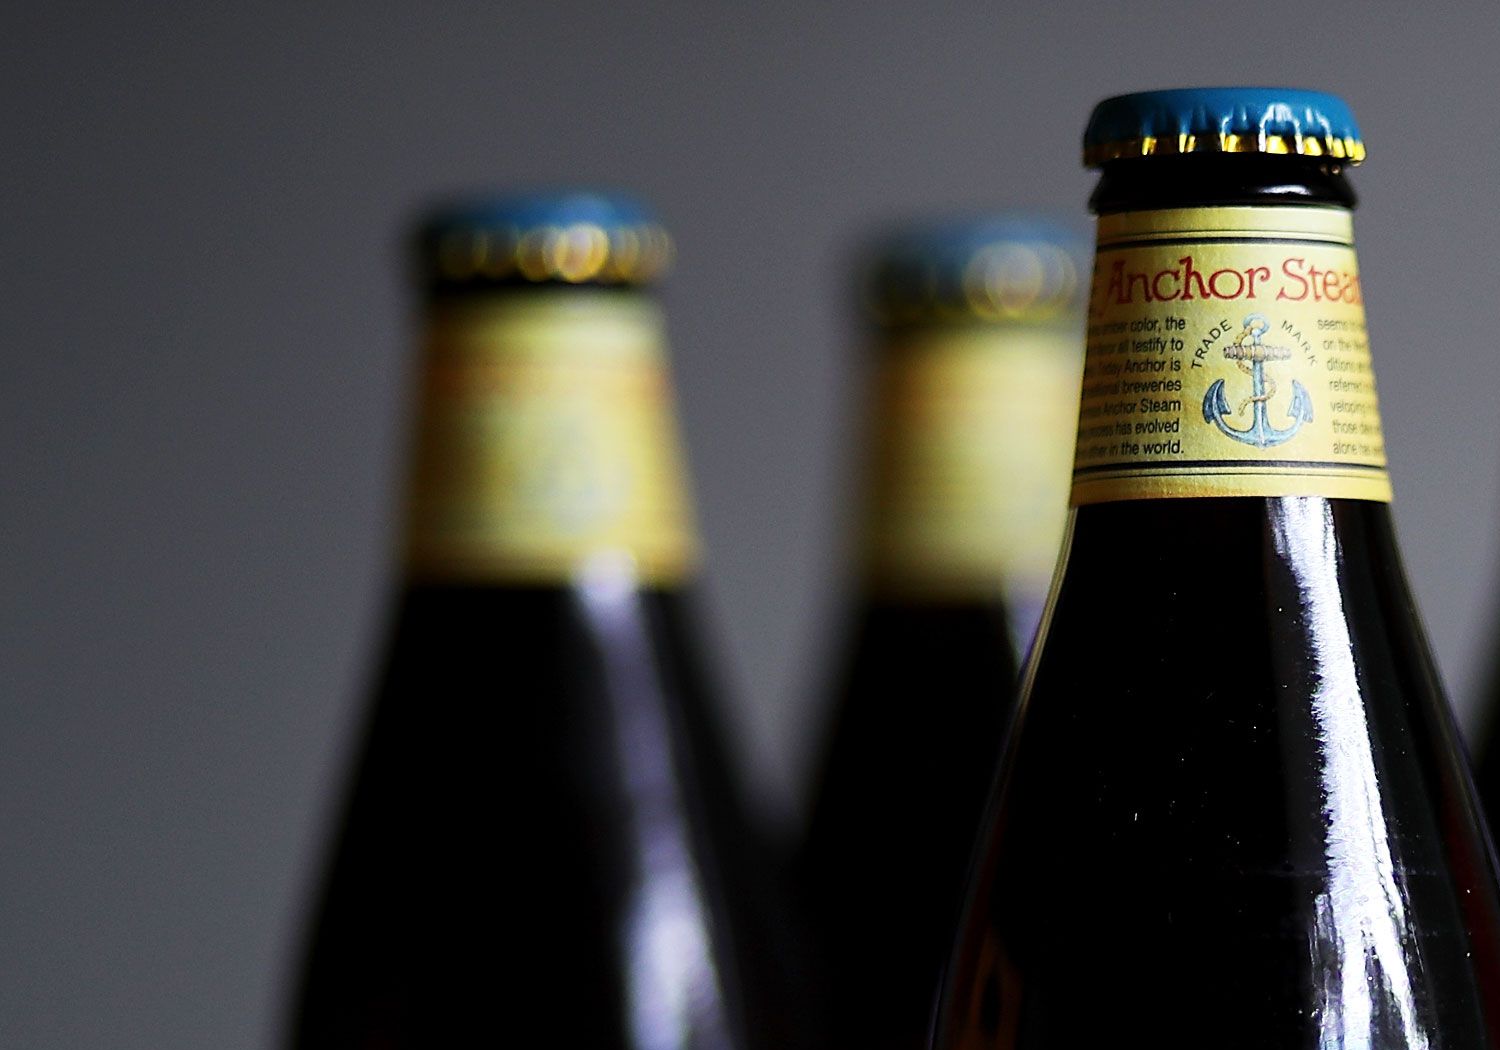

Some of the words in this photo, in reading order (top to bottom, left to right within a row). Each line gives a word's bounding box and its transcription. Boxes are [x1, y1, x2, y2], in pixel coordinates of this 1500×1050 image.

[1100, 256, 1271, 312] Anchor
[1276, 257, 1361, 304] Stea
[1131, 318, 1161, 333] color,
[1165, 317, 1185, 331] the
[1132, 337, 1167, 354] testify
[1170, 337, 1183, 351] to
[1191, 319, 1232, 369] TRADE
[1282, 320, 1318, 367] MARK
[1124, 359, 1166, 373] Anchor
[1170, 358, 1181, 371] is
[1122, 377, 1182, 393] breweries
[1104, 400, 1137, 415] Anchor
[1140, 398, 1181, 413] Steam
[1135, 418, 1179, 435] evolved
[1121, 440, 1139, 455] the
[1143, 440, 1184, 455] world.
